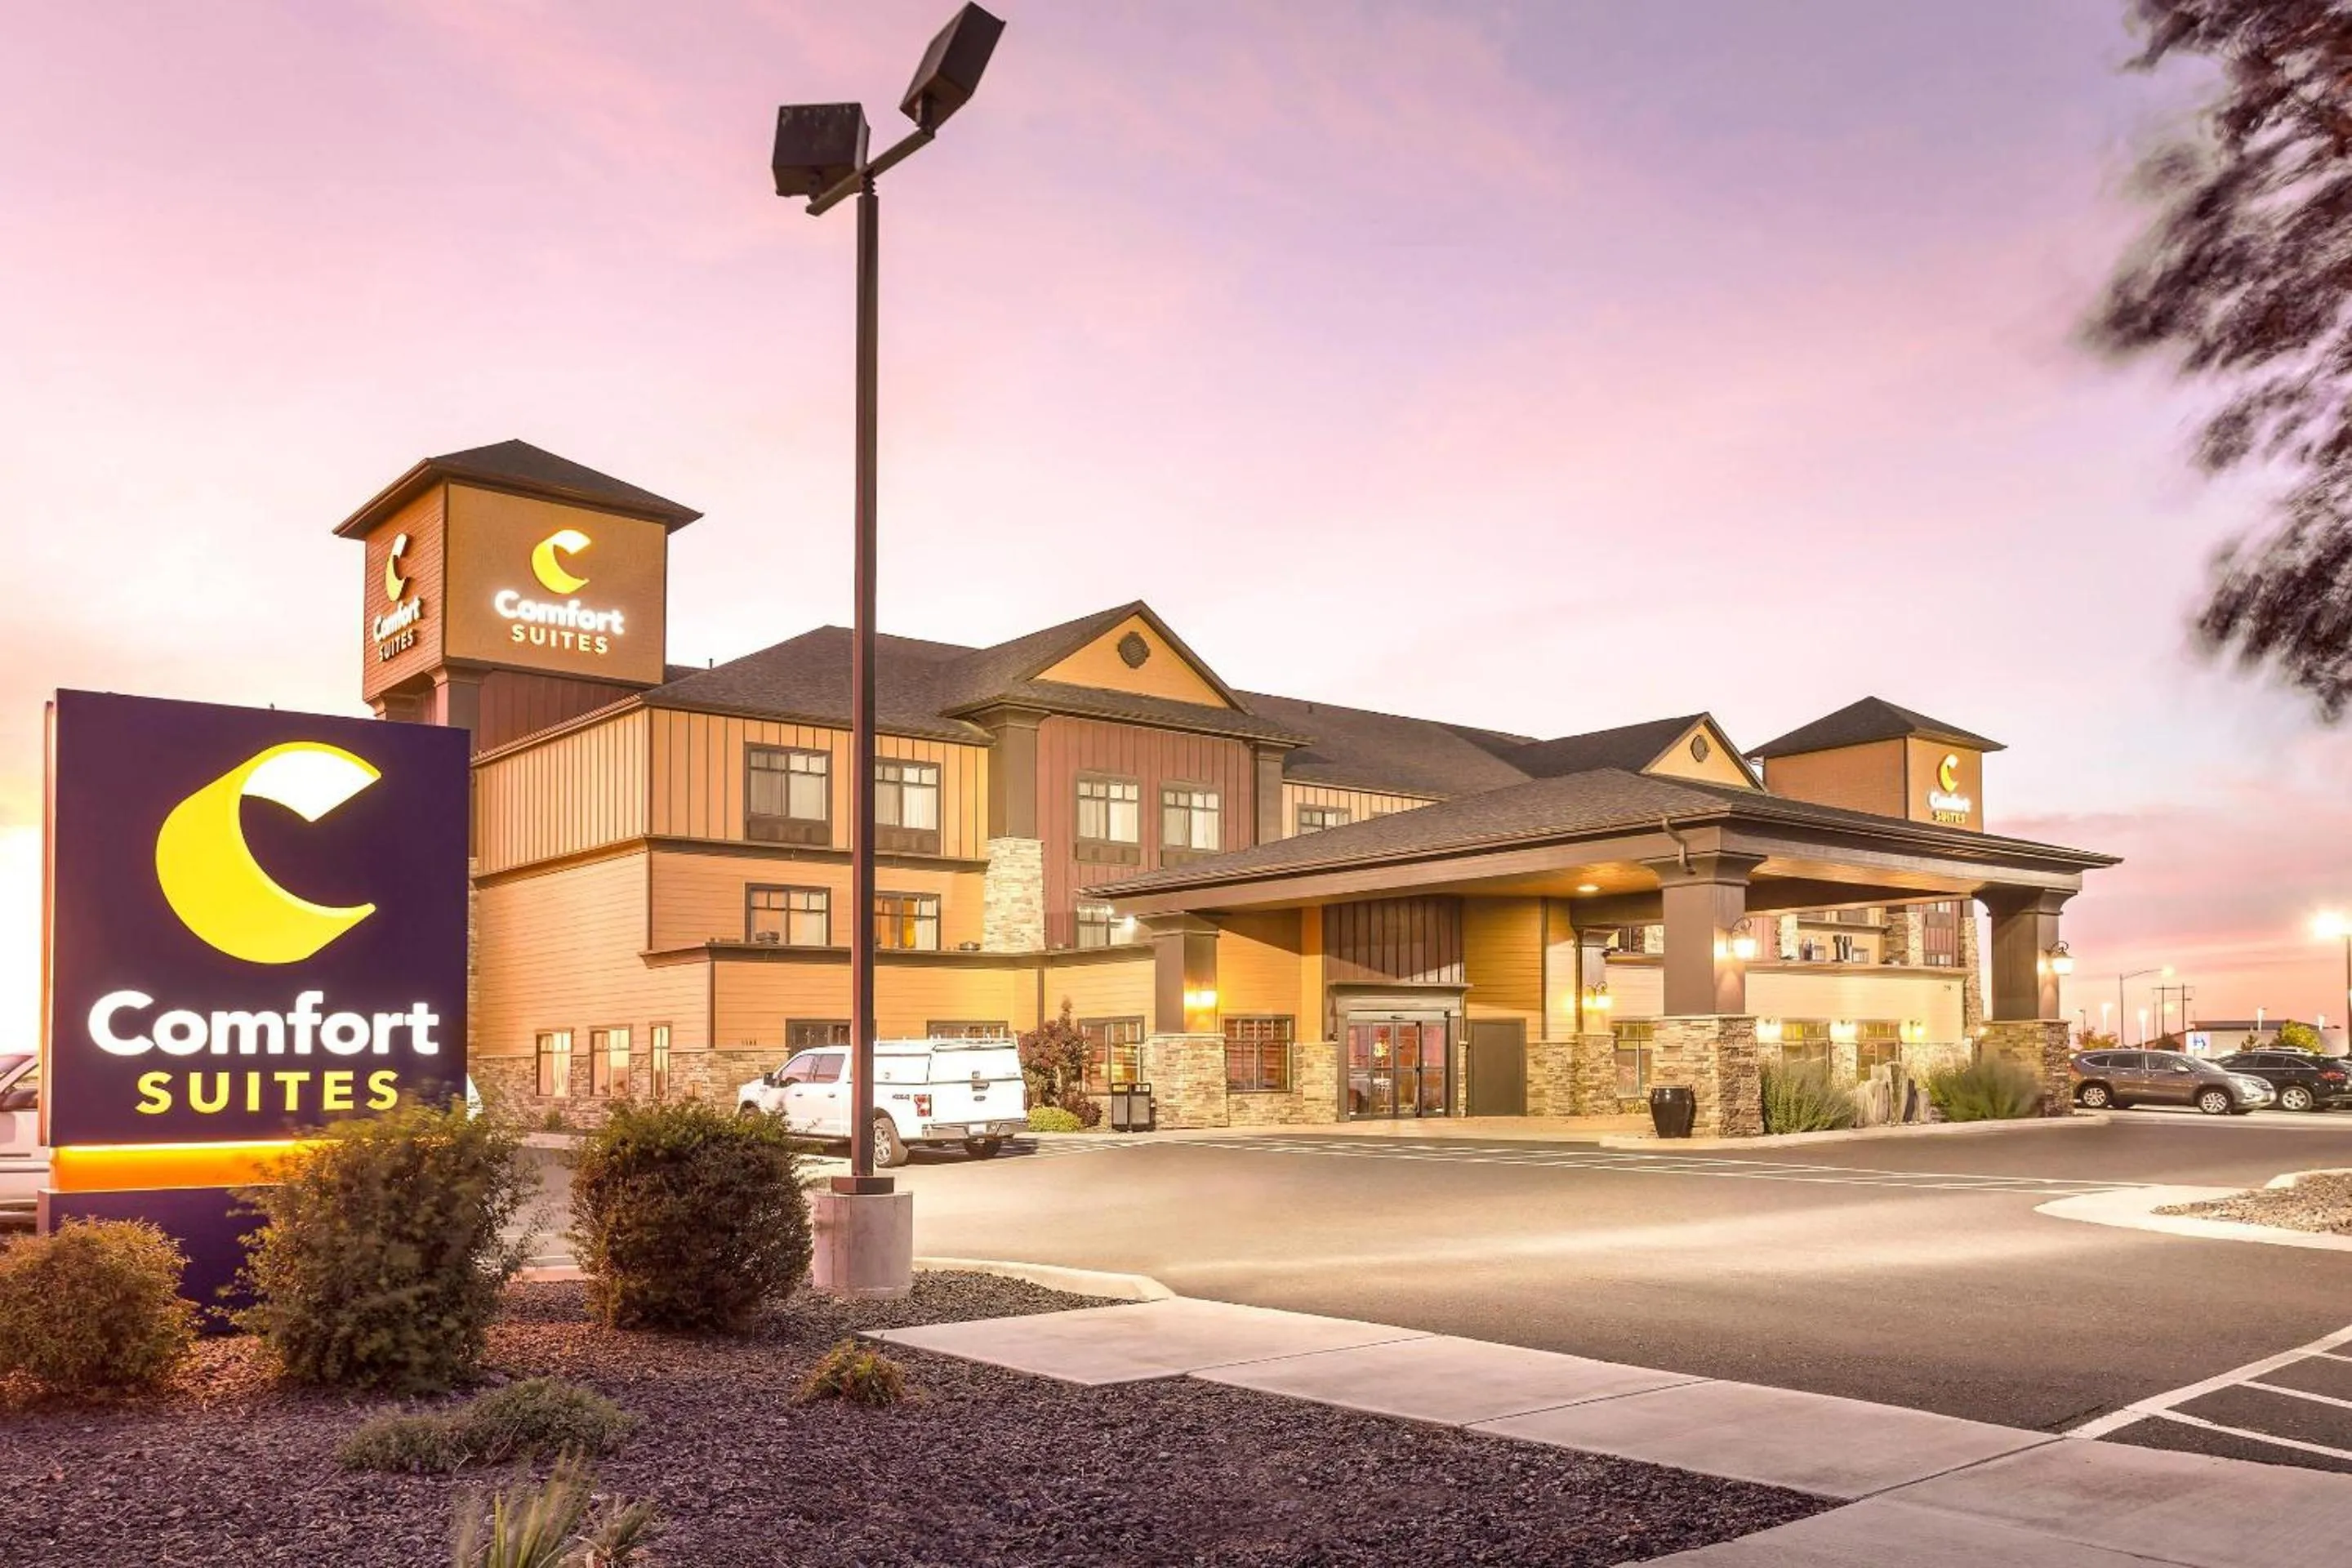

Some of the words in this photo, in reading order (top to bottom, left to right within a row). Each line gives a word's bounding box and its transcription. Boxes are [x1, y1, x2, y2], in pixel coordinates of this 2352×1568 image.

[372, 595, 421, 644] Comfort
[494, 589, 625, 635] Comfort
[378, 627, 413, 663] SUITES
[511, 623, 608, 654] SUITES
[87, 990, 439, 1056] Comfort
[134, 1070, 399, 1114] SUITES
